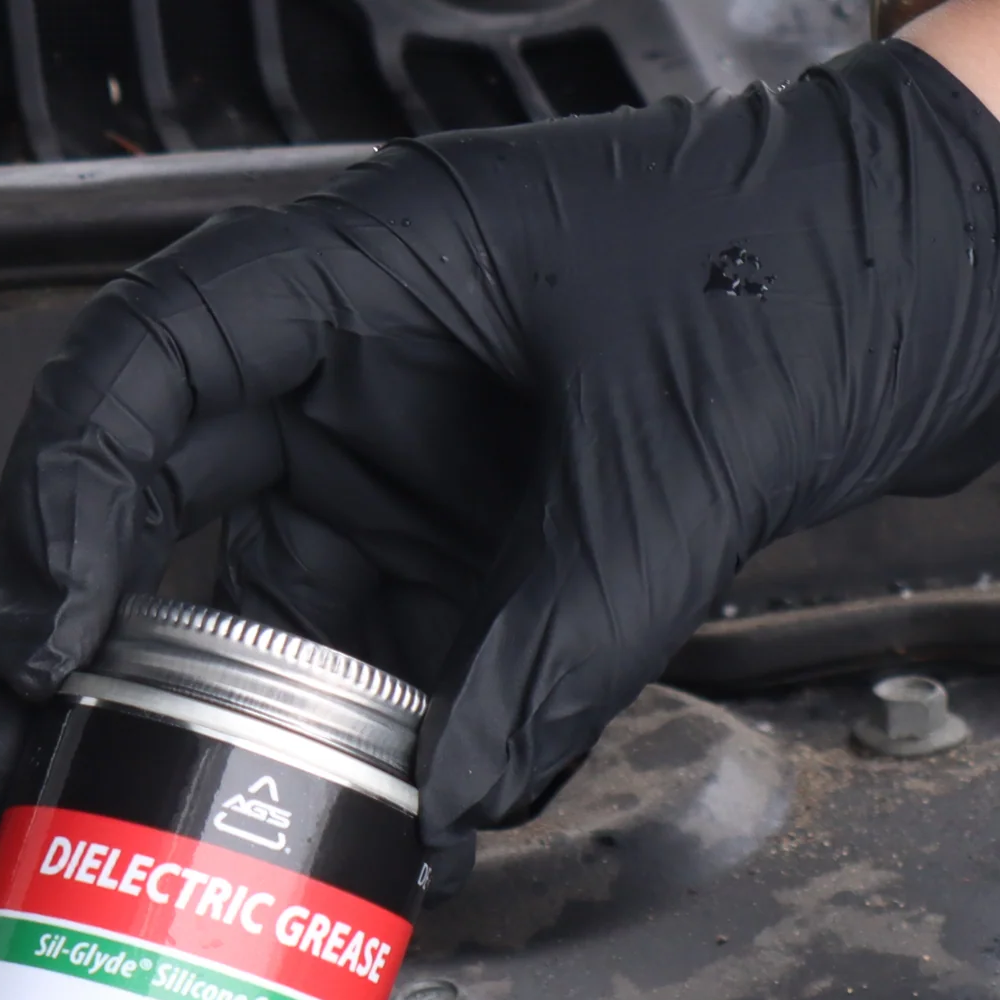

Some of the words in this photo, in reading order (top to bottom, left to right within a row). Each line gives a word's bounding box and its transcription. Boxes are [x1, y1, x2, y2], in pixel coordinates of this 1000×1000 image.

[221, 793, 293, 829] AGS
[39, 835, 276, 934] DIELECTRIC
[275, 905, 391, 984] GREASE
